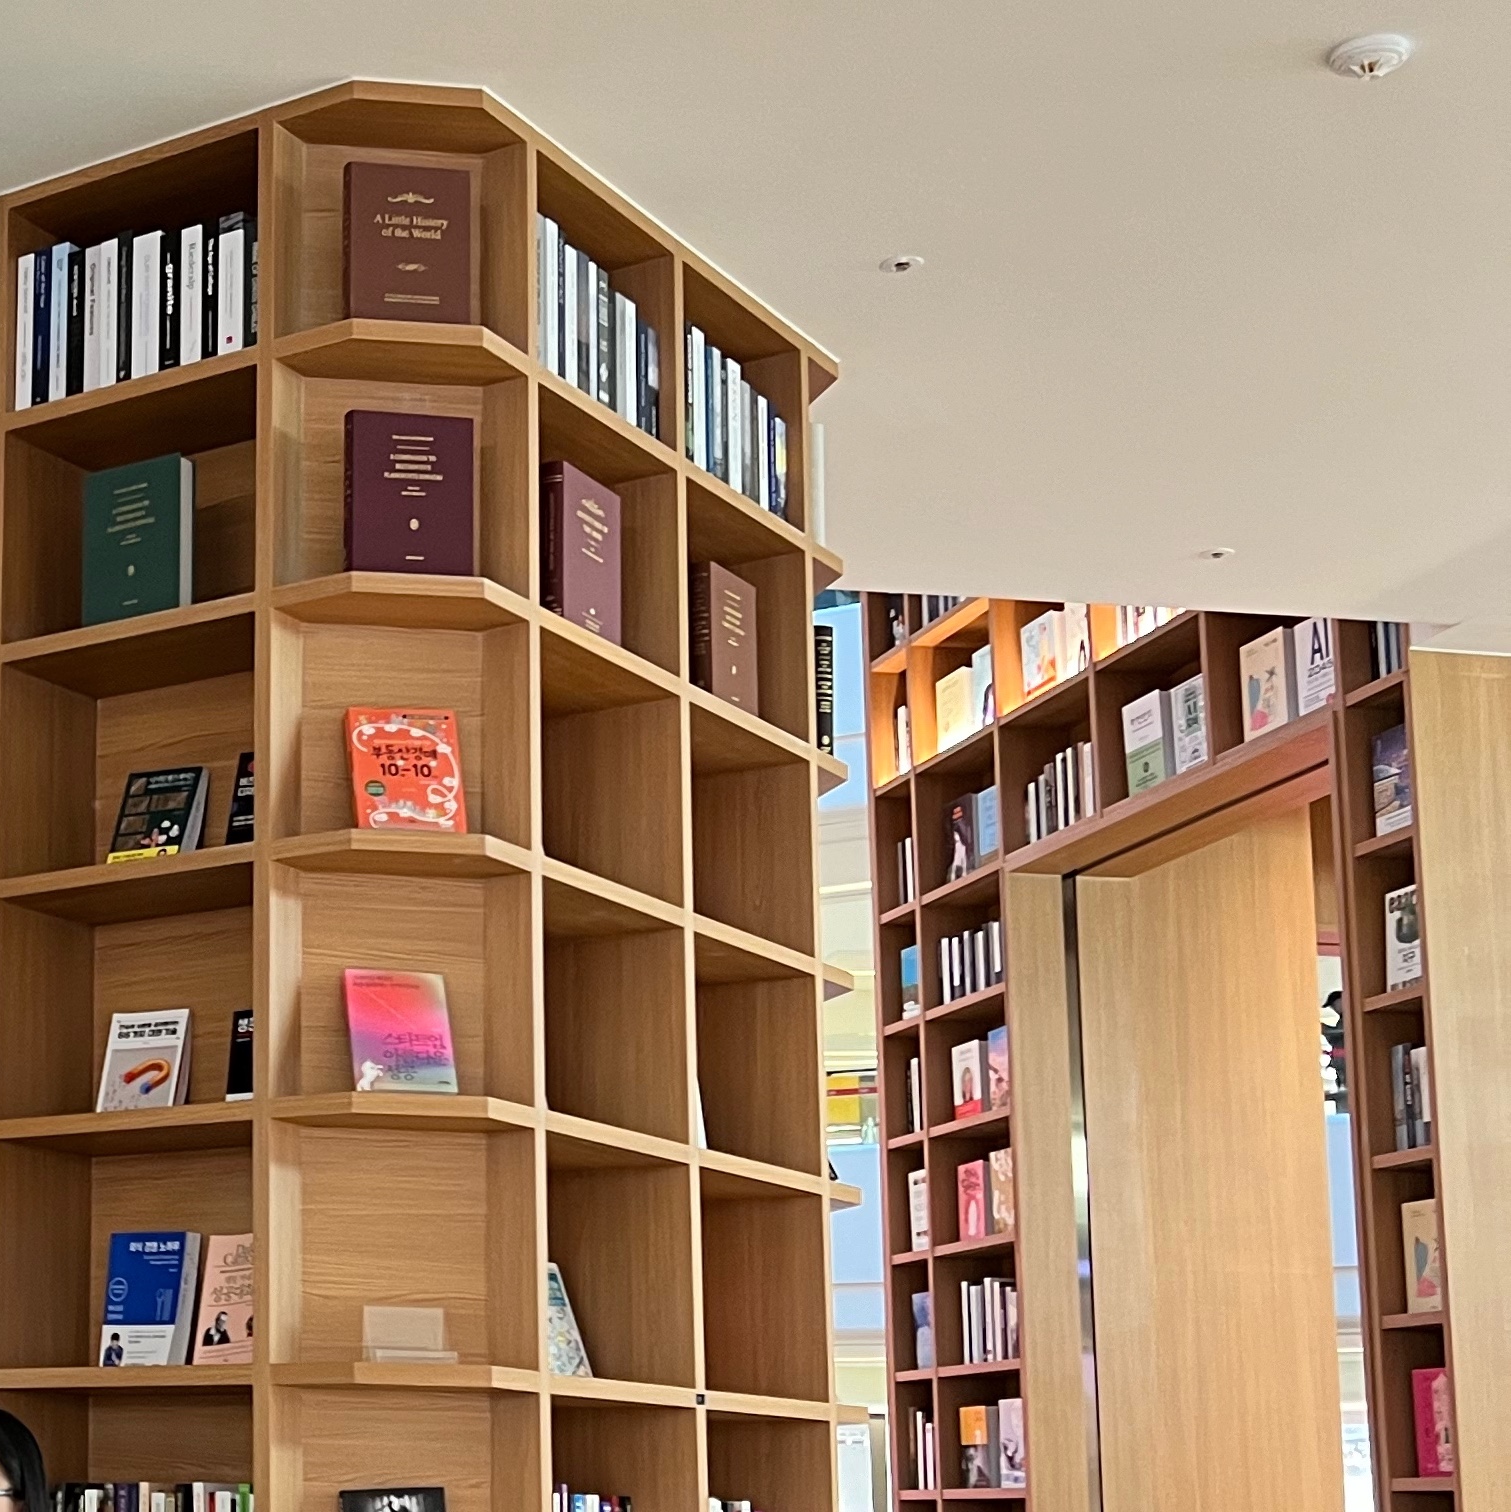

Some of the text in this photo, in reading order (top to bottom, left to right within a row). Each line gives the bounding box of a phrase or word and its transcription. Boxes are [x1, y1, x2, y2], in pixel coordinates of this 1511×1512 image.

[373, 213, 448, 230] A Little History
[381, 226, 441, 239] of the World
[165, 263, 174, 315] granite
[1310, 617, 1330, 666] AI
[380, 763, 432, 778] 10-10
